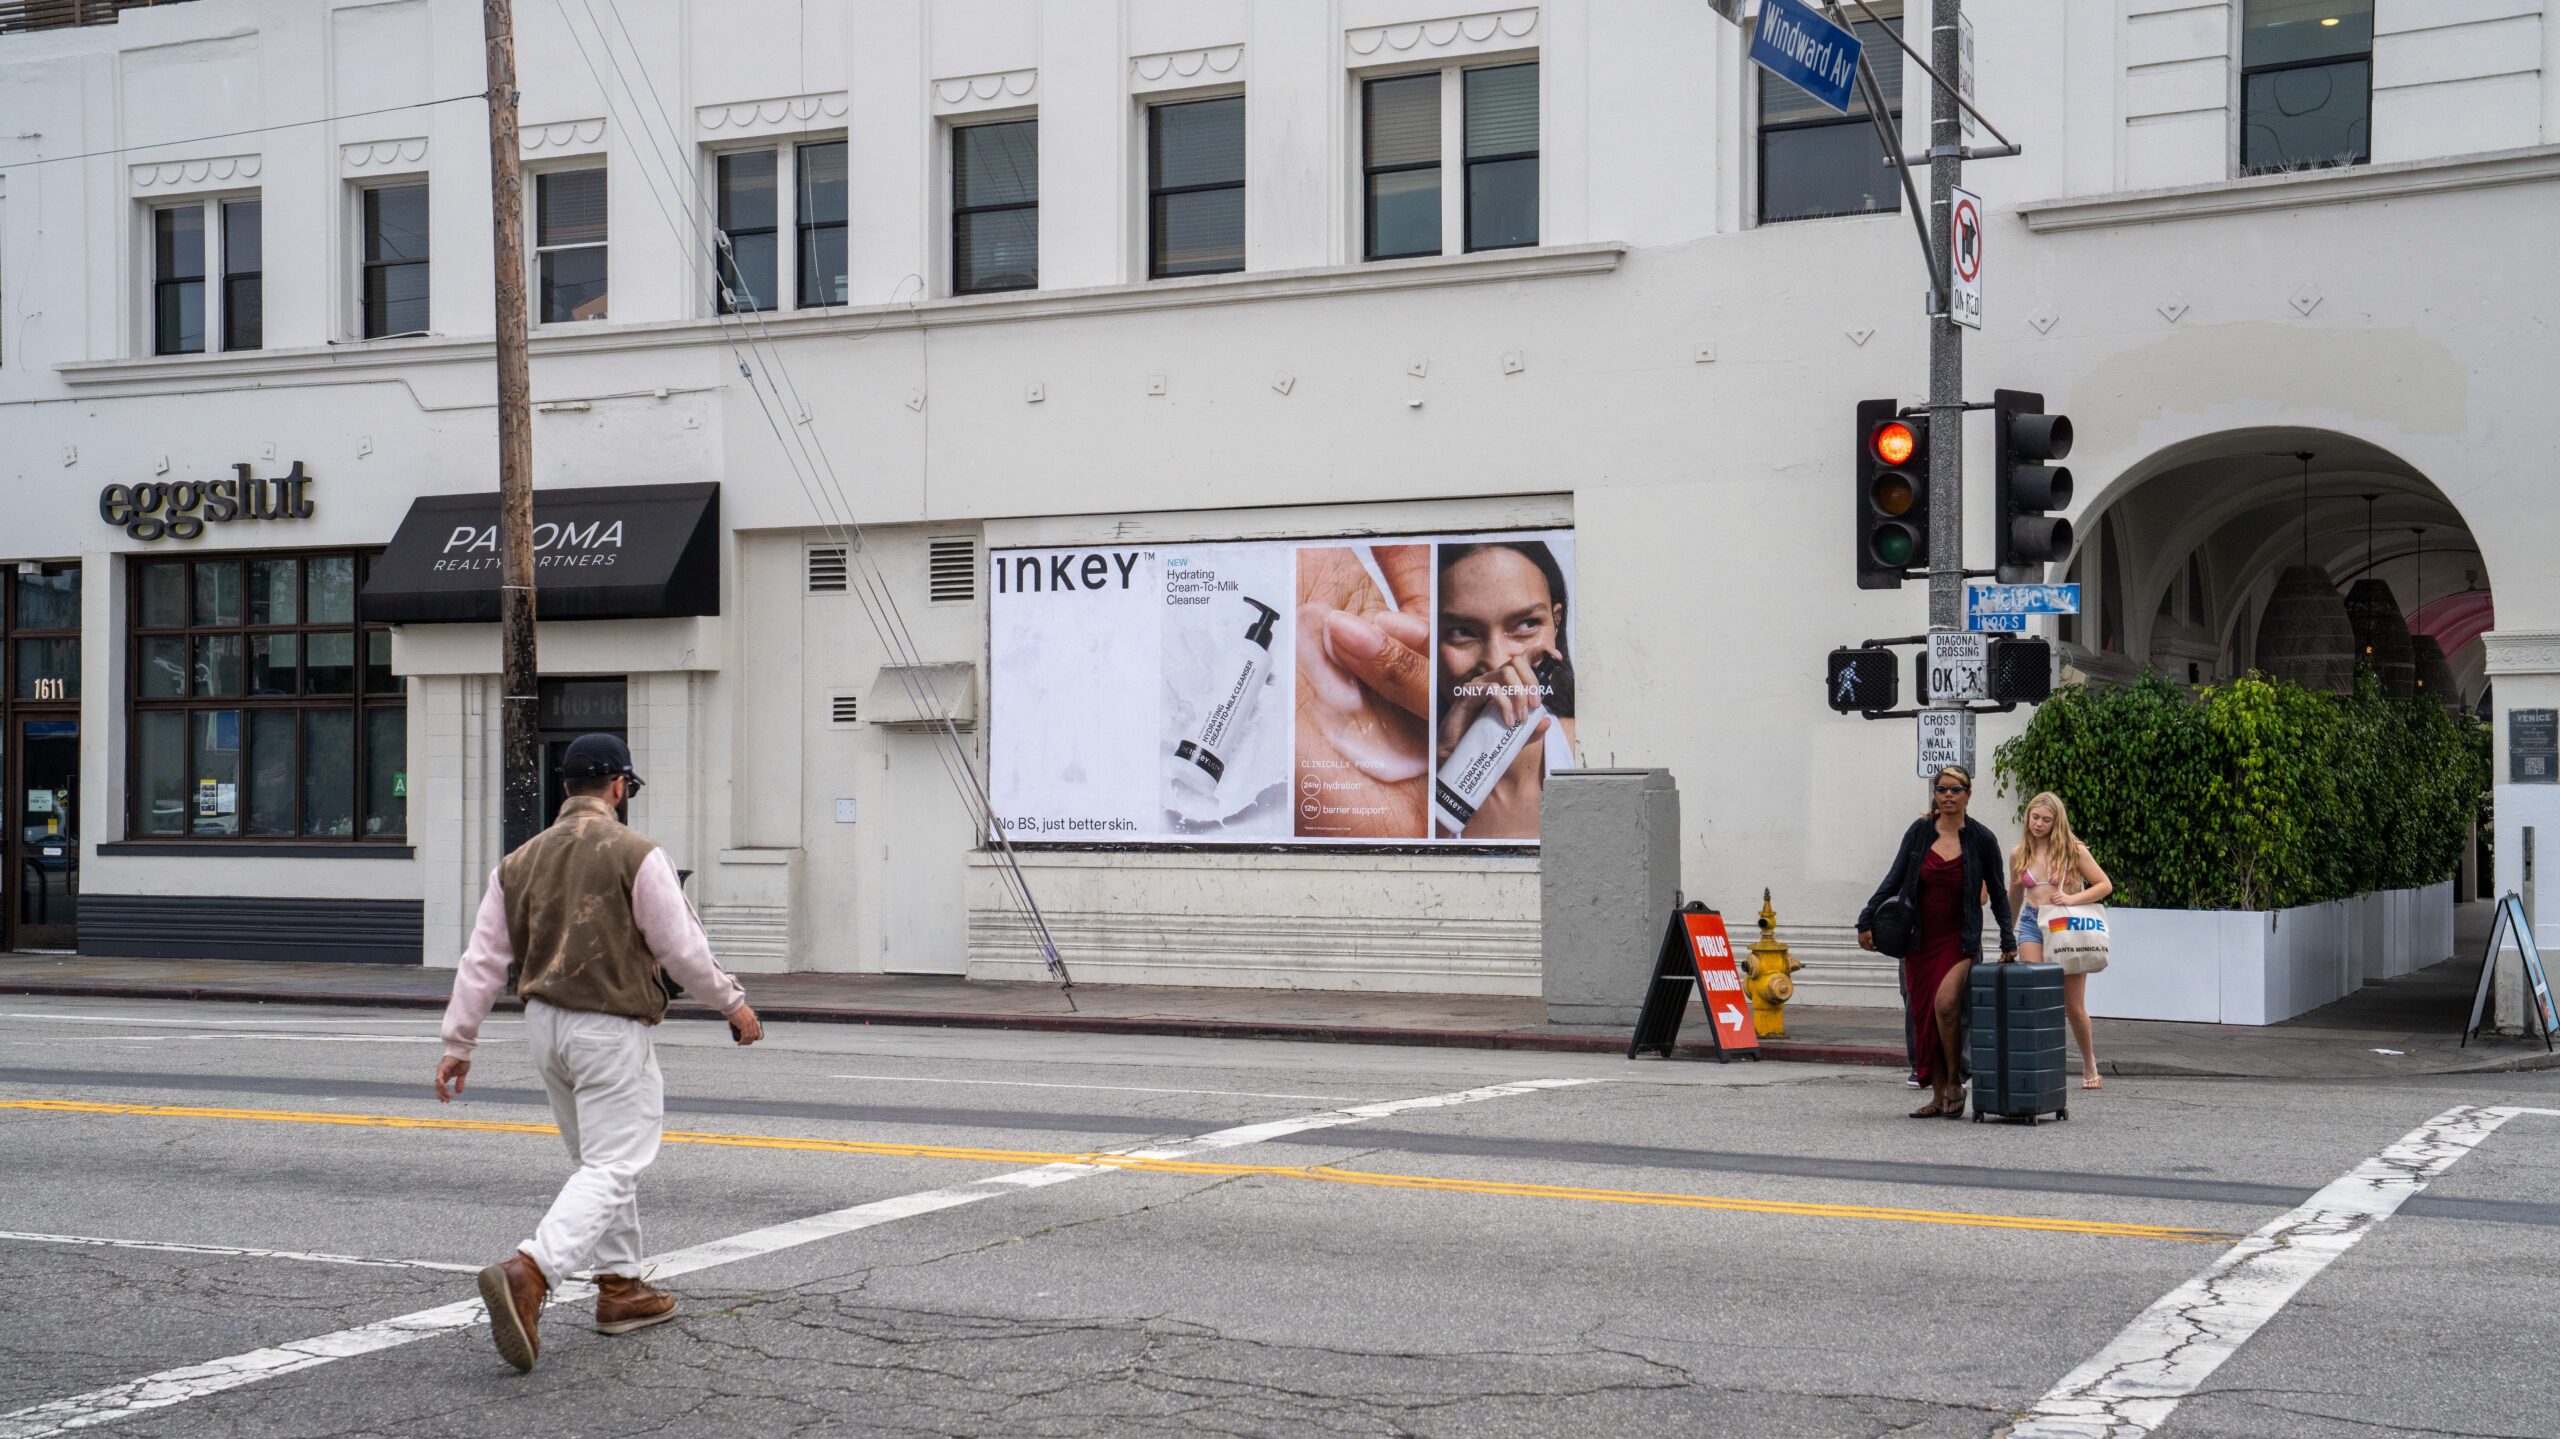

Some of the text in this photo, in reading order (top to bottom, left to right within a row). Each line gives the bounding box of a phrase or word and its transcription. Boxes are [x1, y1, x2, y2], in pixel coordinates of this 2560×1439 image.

[1762, 1, 1852, 88] Windward Av
[1954, 289, 1964, 311] ON
[99, 461, 315, 541] eggslut
[443, 520, 623, 553] PAOMA
[433, 553, 618, 571] REALTY RTNERS
[1167, 558, 1189, 567] NEW
[1167, 569, 1215, 582] Hydrating
[1166, 580, 1240, 593] Cream-To-Milk
[1166, 594, 1211, 605] Cleanser
[1977, 615, 2020, 630] 100 S
[1936, 635, 1979, 646] DIAGONAL
[1936, 646, 1979, 657] CROSSING
[1932, 667, 1954, 692] OK
[34, 678, 65, 700] 1611
[1453, 684, 1554, 697] ONLY AT SEPHORA
[1208, 693, 1237, 747] CREAM-TO-MILK
[1234, 659, 1254, 695] CLEANSER
[1201, 703, 1225, 743] HYDRATING
[1923, 714, 1956, 726] CROSS
[2517, 714, 2552, 722] VENICE
[1934, 727, 1946, 737] ON
[1926, 737, 1953, 749] WALK
[1464, 744, 1503, 795] CREAM-TO-MILK
[1500, 719, 1521, 745] CLEANS
[1922, 750, 1957, 762] SIGNAL
[1301, 760, 1350, 769] CLINICALLY
[1458, 751, 1488, 790] HYDRATING
[394, 778, 406, 792] A
[1303, 781, 1320, 789] 24hr
[1304, 804, 1319, 812] 12hr
[1322, 805, 1350, 814] barrier
[996, 817, 1015, 830] No
[1018, 817, 1040, 832] BS,
[1042, 817, 1065, 833] just
[2065, 916, 2106, 932] RIDE
[1695, 935, 1729, 957] PUBLIC
[2053, 946, 2075, 954] SANTA
[1702, 970, 1741, 991] PARKING
